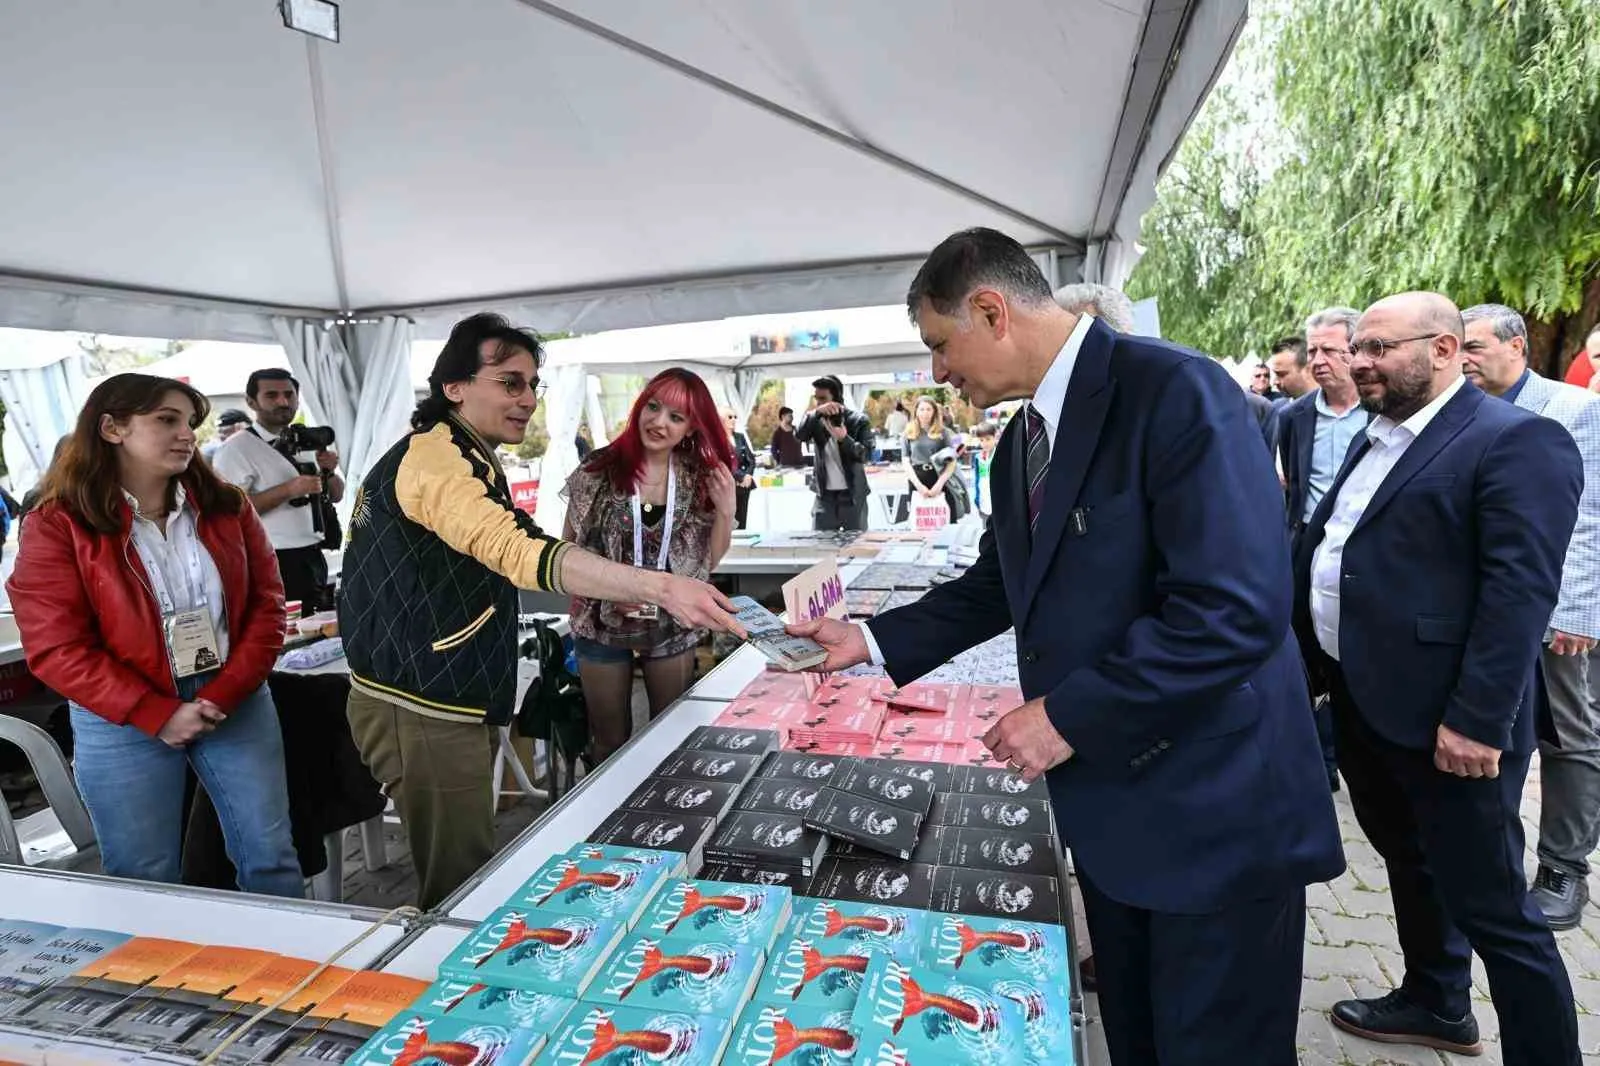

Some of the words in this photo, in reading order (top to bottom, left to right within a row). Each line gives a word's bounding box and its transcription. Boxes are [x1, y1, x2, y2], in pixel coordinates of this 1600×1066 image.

[808, 573, 844, 621] ALANA
[805, 902, 837, 936] LOR
[603, 938, 661, 995] KLOR
[774, 939, 814, 995] KLOR
[873, 961, 912, 1028] KLOR
[557, 1008, 616, 1066] LOR
